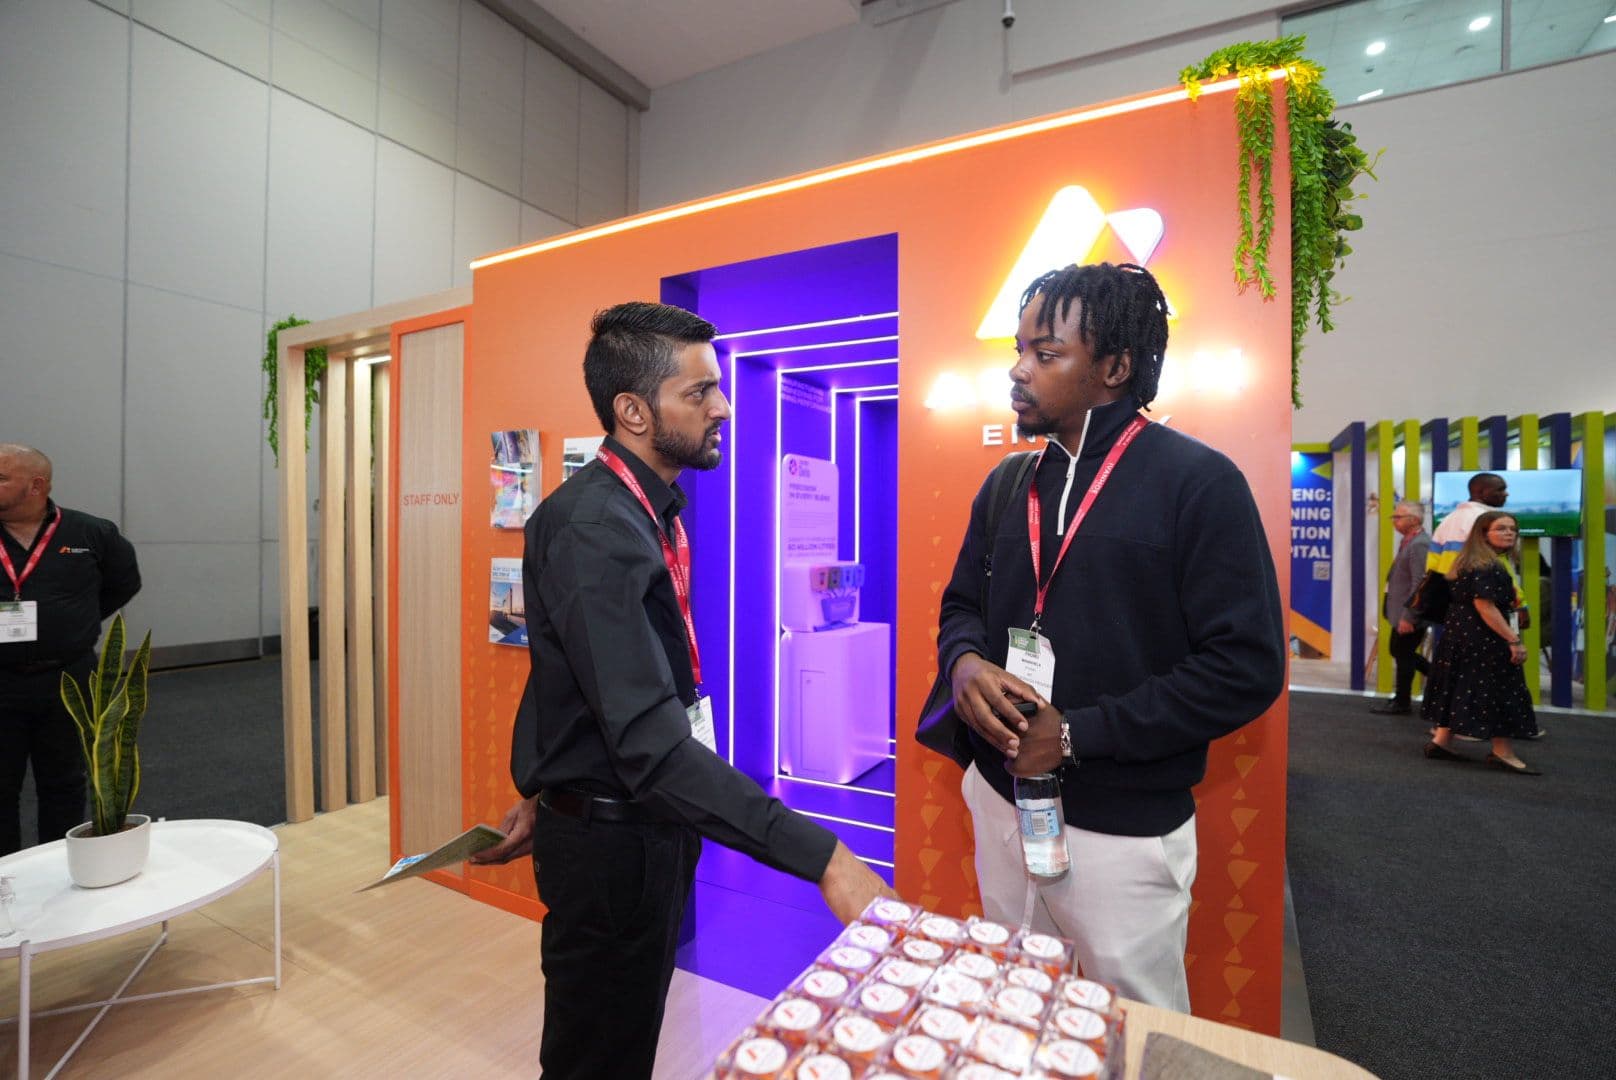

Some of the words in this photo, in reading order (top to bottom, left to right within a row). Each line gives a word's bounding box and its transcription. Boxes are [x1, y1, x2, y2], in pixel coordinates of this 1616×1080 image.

[403, 494, 431, 505] STAFF
[433, 493, 458, 505] ONLY
[1292, 488, 1332, 501] ENG:
[1291, 507, 1331, 521] NING
[1291, 526, 1331, 539] TION
[1291, 545, 1331, 558] ITAL
